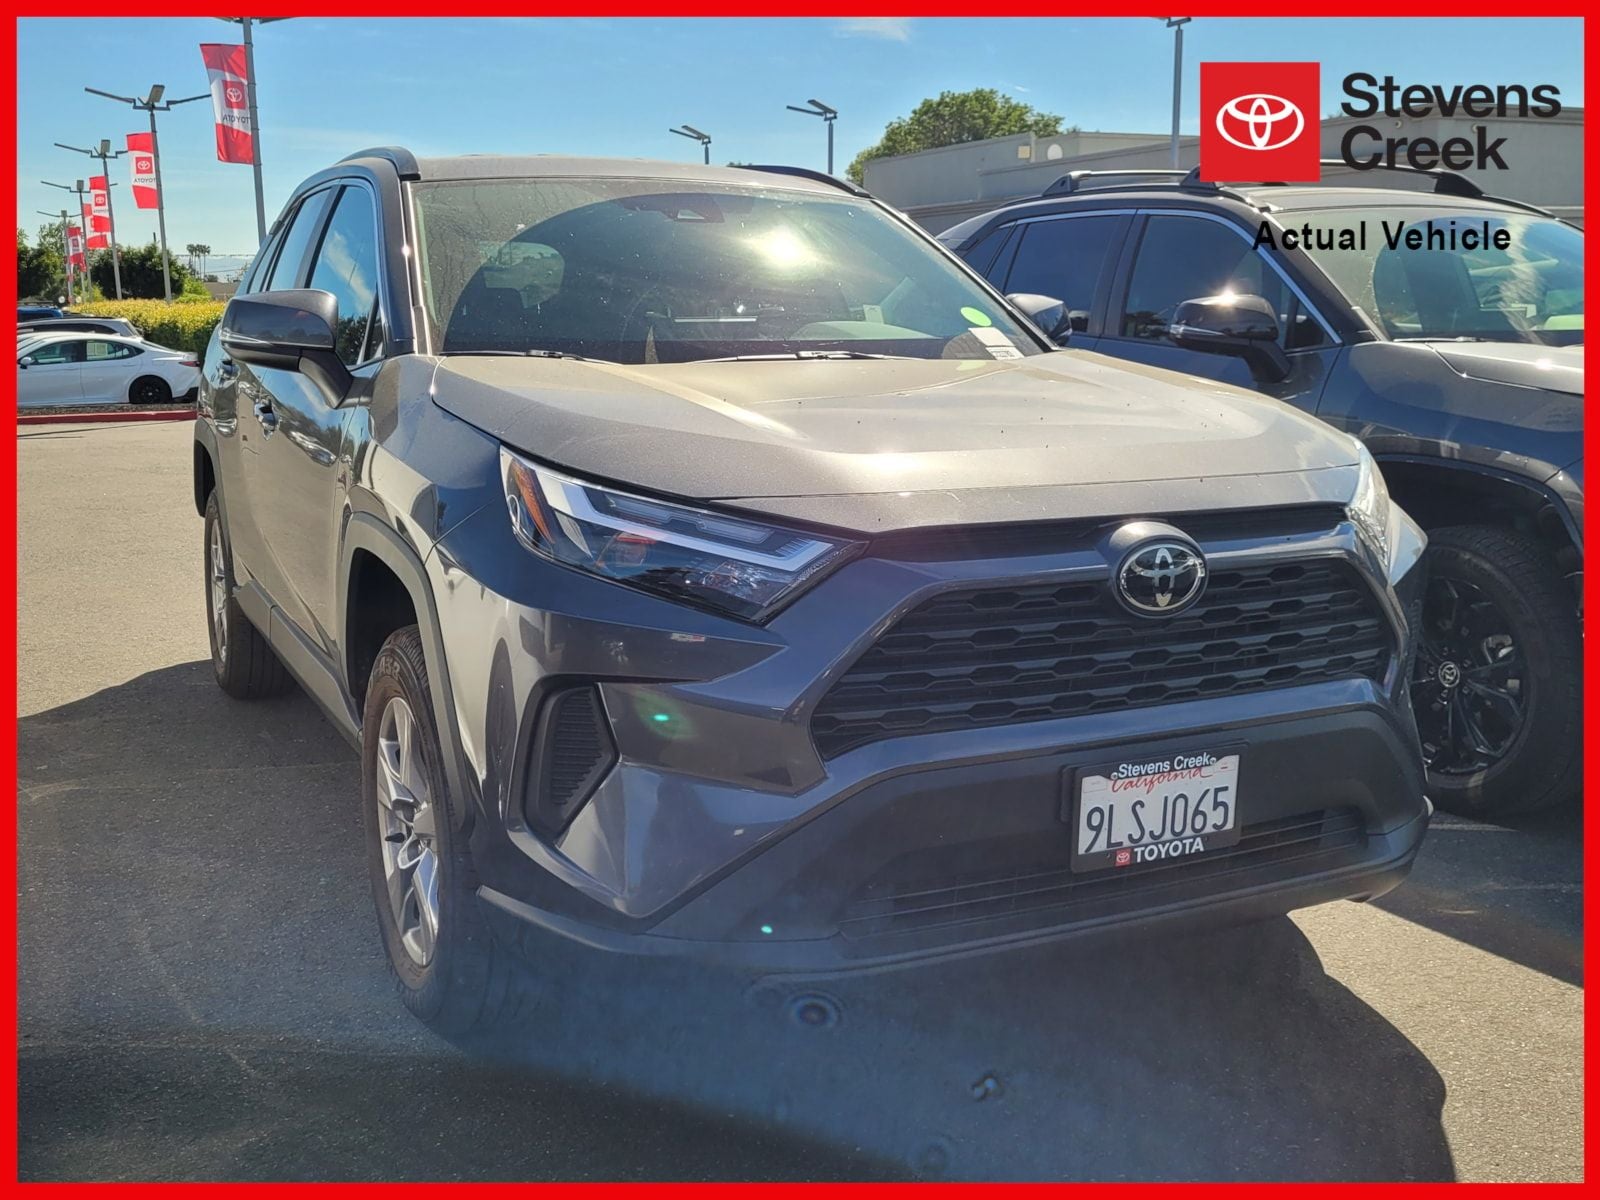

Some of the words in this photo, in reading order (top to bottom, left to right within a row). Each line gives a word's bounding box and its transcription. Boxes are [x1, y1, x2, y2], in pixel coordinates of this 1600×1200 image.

[1118, 760, 1170, 778] Stevens
[1174, 752, 1211, 769] Creek
[1084, 785, 1229, 853] 9LSJ065
[1133, 836, 1204, 863] TOYOTA
